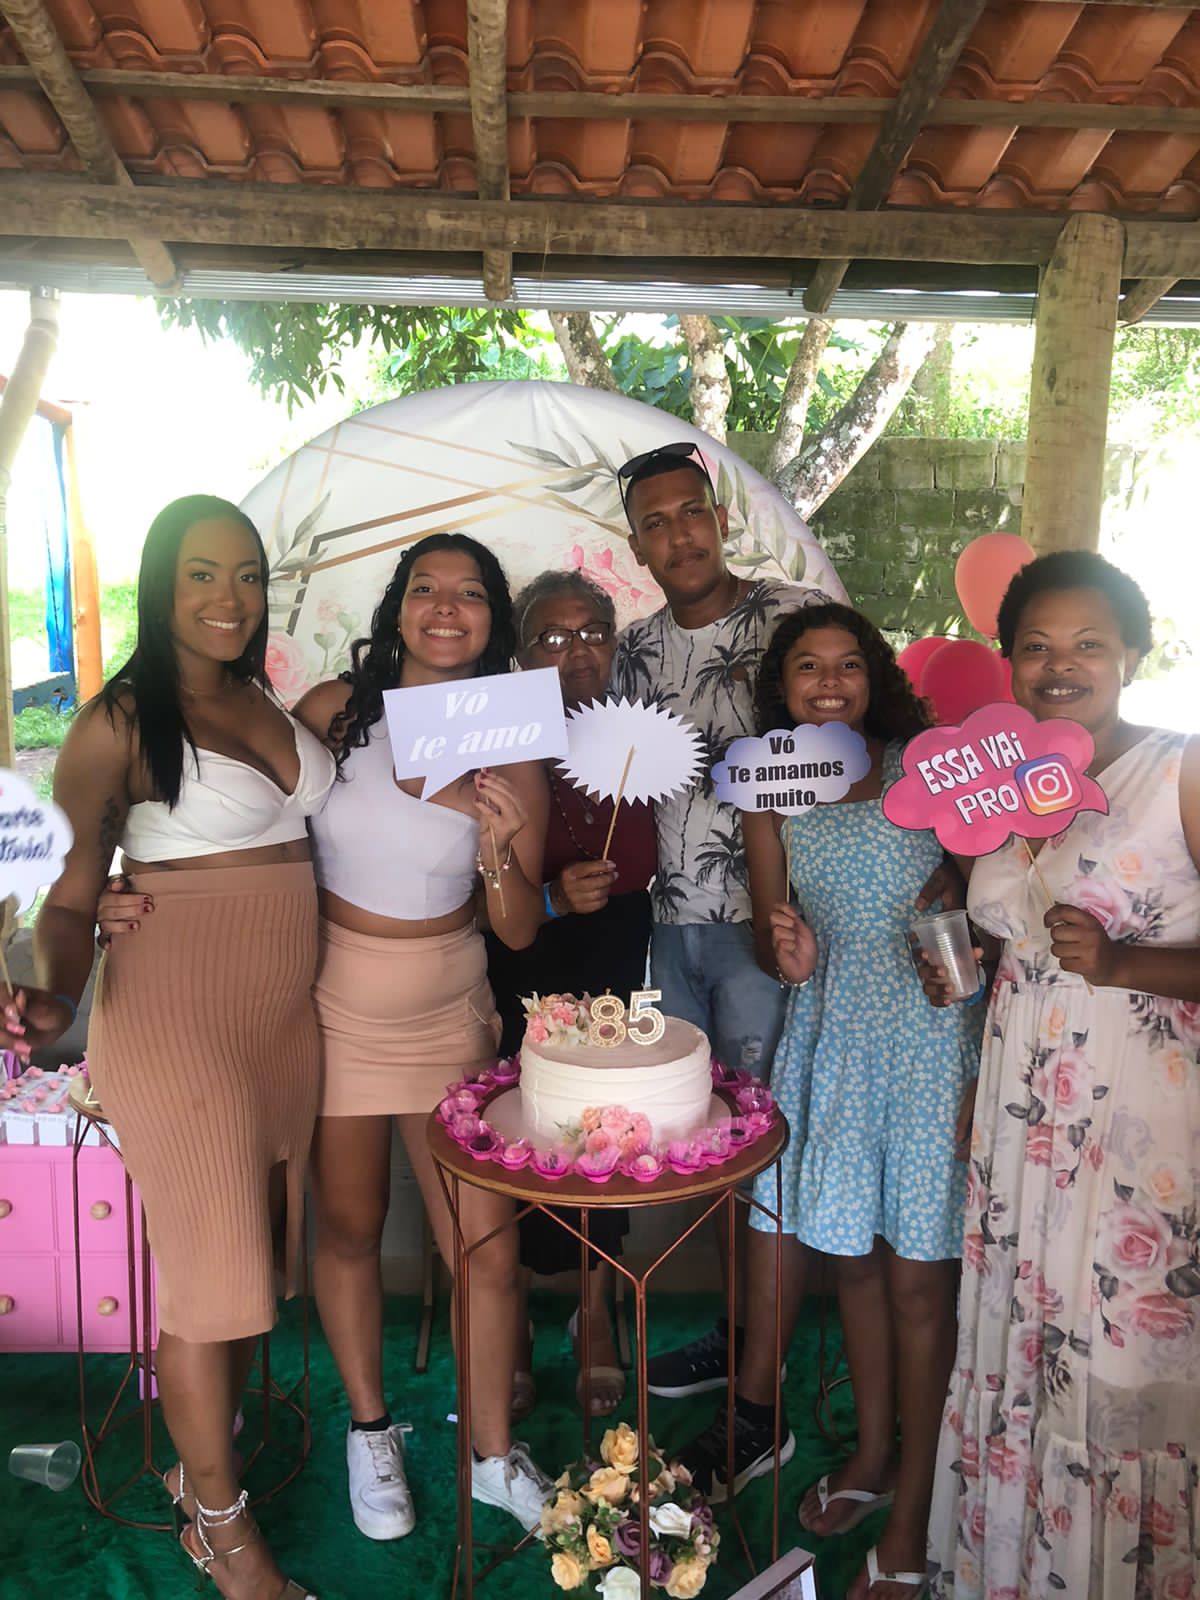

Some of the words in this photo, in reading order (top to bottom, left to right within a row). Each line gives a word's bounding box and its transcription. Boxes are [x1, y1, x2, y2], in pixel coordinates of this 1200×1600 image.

[445, 686, 489, 720] Vó
[409, 735, 447, 762] te
[457, 721, 542, 755] amo
[769, 734, 795, 755] Vó
[727, 765, 751, 784] Te
[755, 760, 845, 782] amamos
[917, 743, 985, 796] ESSA
[756, 789, 816, 809] muito
[955, 784, 1020, 825] PRO
[589, 990, 666, 1048] 85
